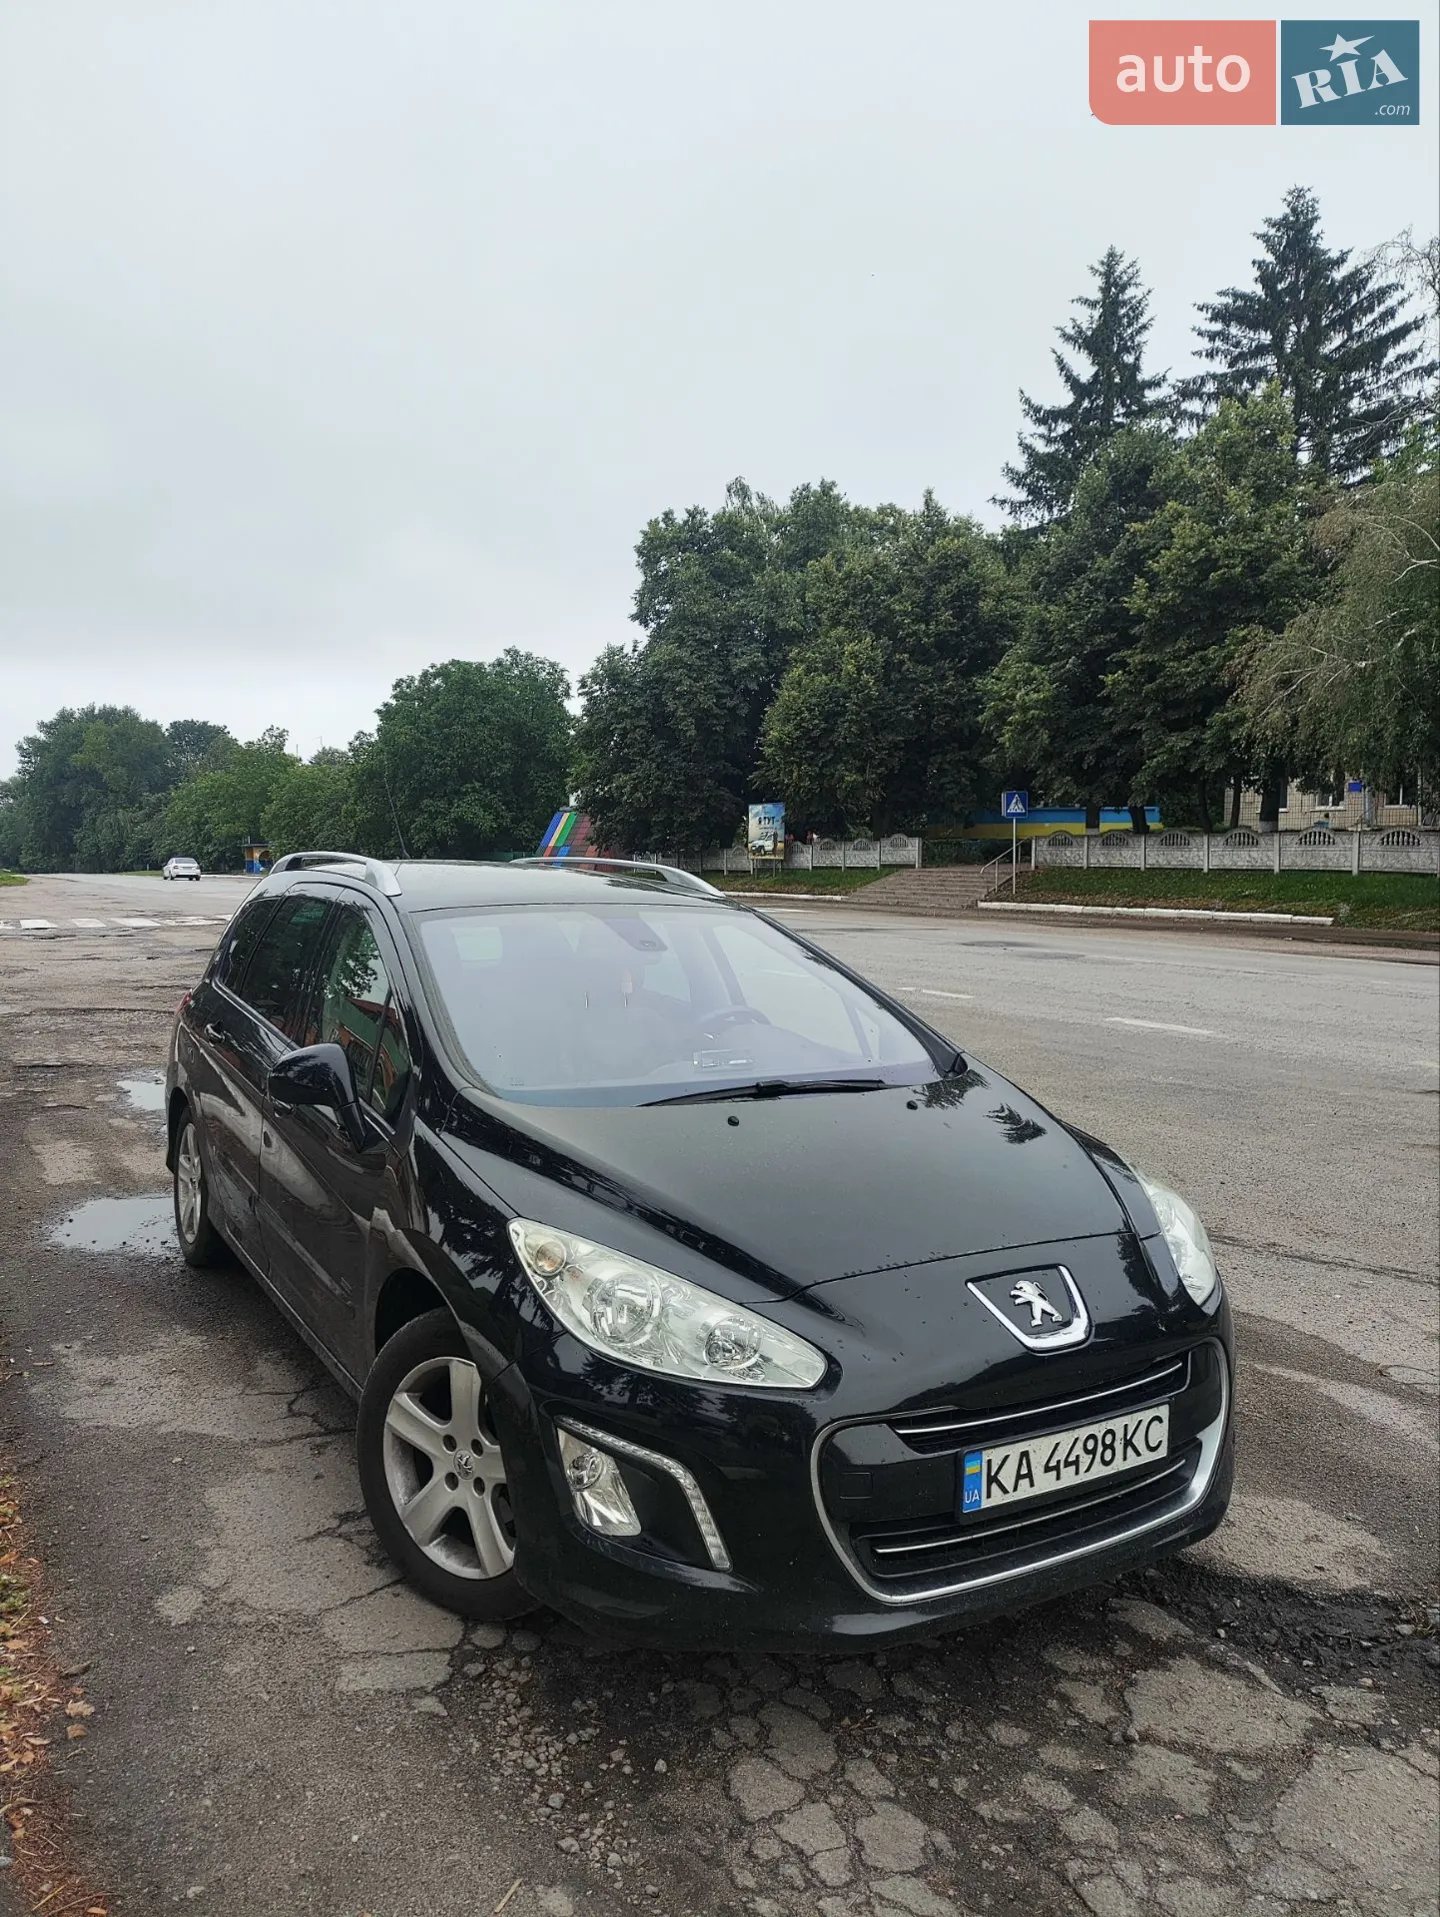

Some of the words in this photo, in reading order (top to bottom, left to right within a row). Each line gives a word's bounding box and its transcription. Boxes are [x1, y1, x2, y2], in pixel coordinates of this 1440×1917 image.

[986, 1450, 1036, 1499] KA
[1043, 1429, 1117, 1482] 4498
[964, 1490, 981, 1504] UA
